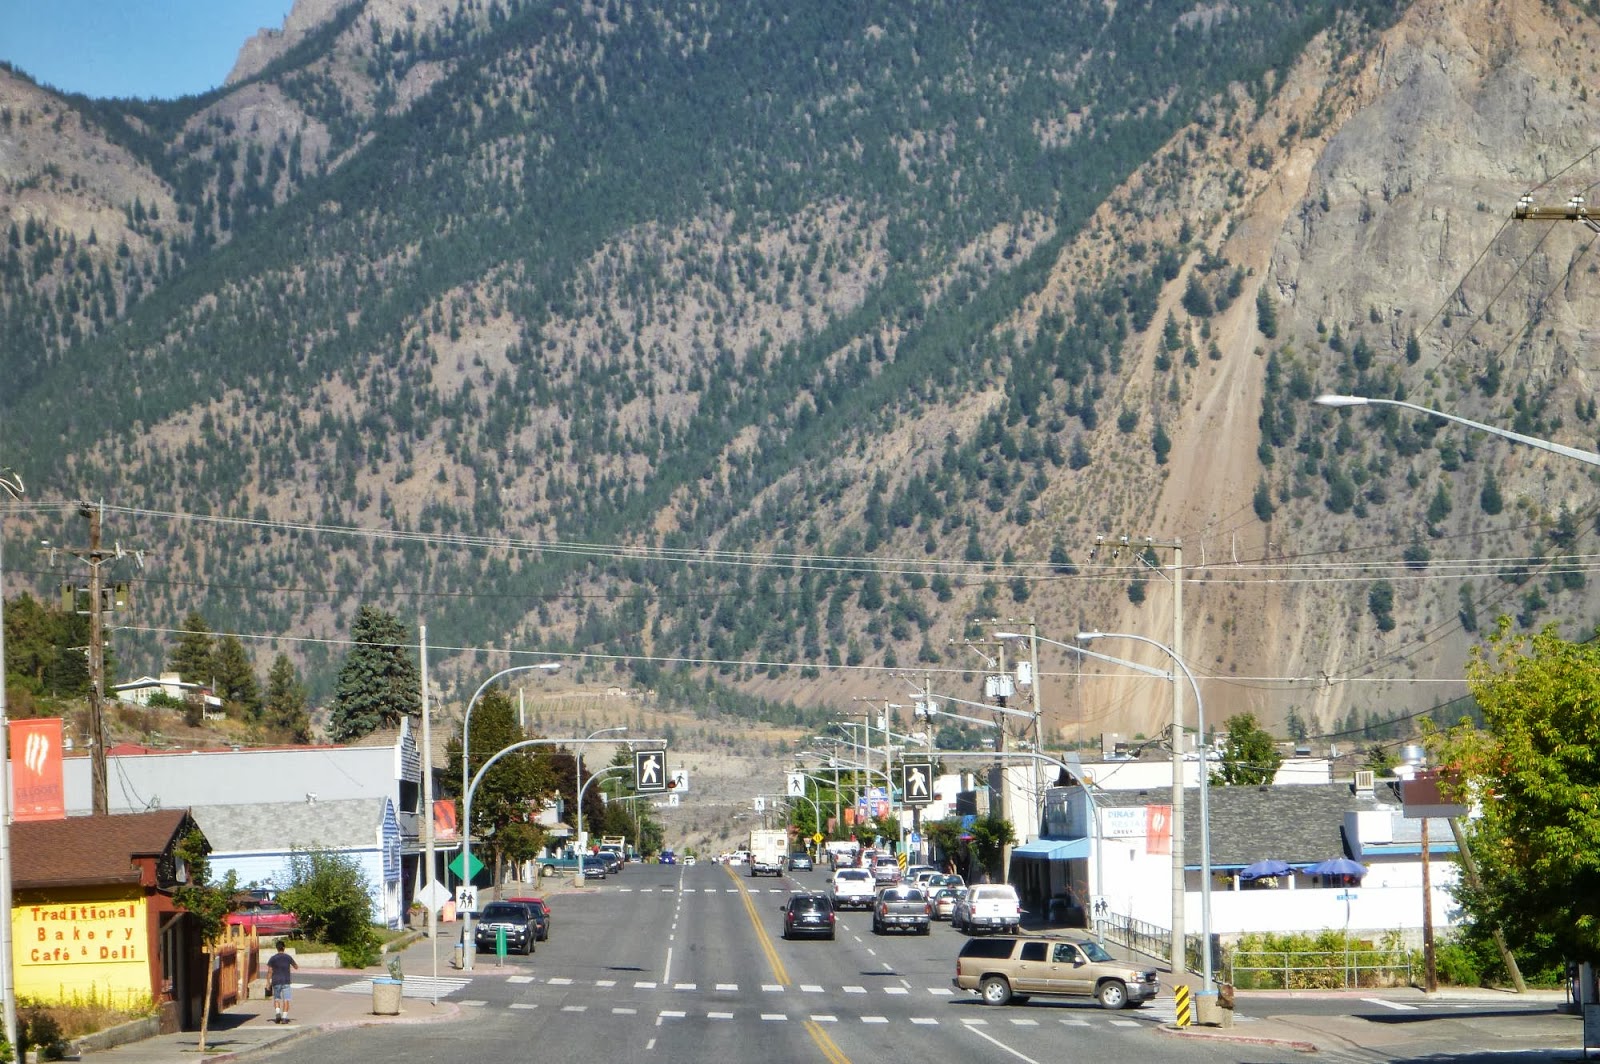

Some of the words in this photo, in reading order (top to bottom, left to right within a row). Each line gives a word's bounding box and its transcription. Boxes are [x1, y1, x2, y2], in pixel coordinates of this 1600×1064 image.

[31, 905, 135, 921] Traditional
[37, 926, 133, 941] Bakery
[31, 947, 70, 962] Café
[100, 945, 135, 960] Deli
